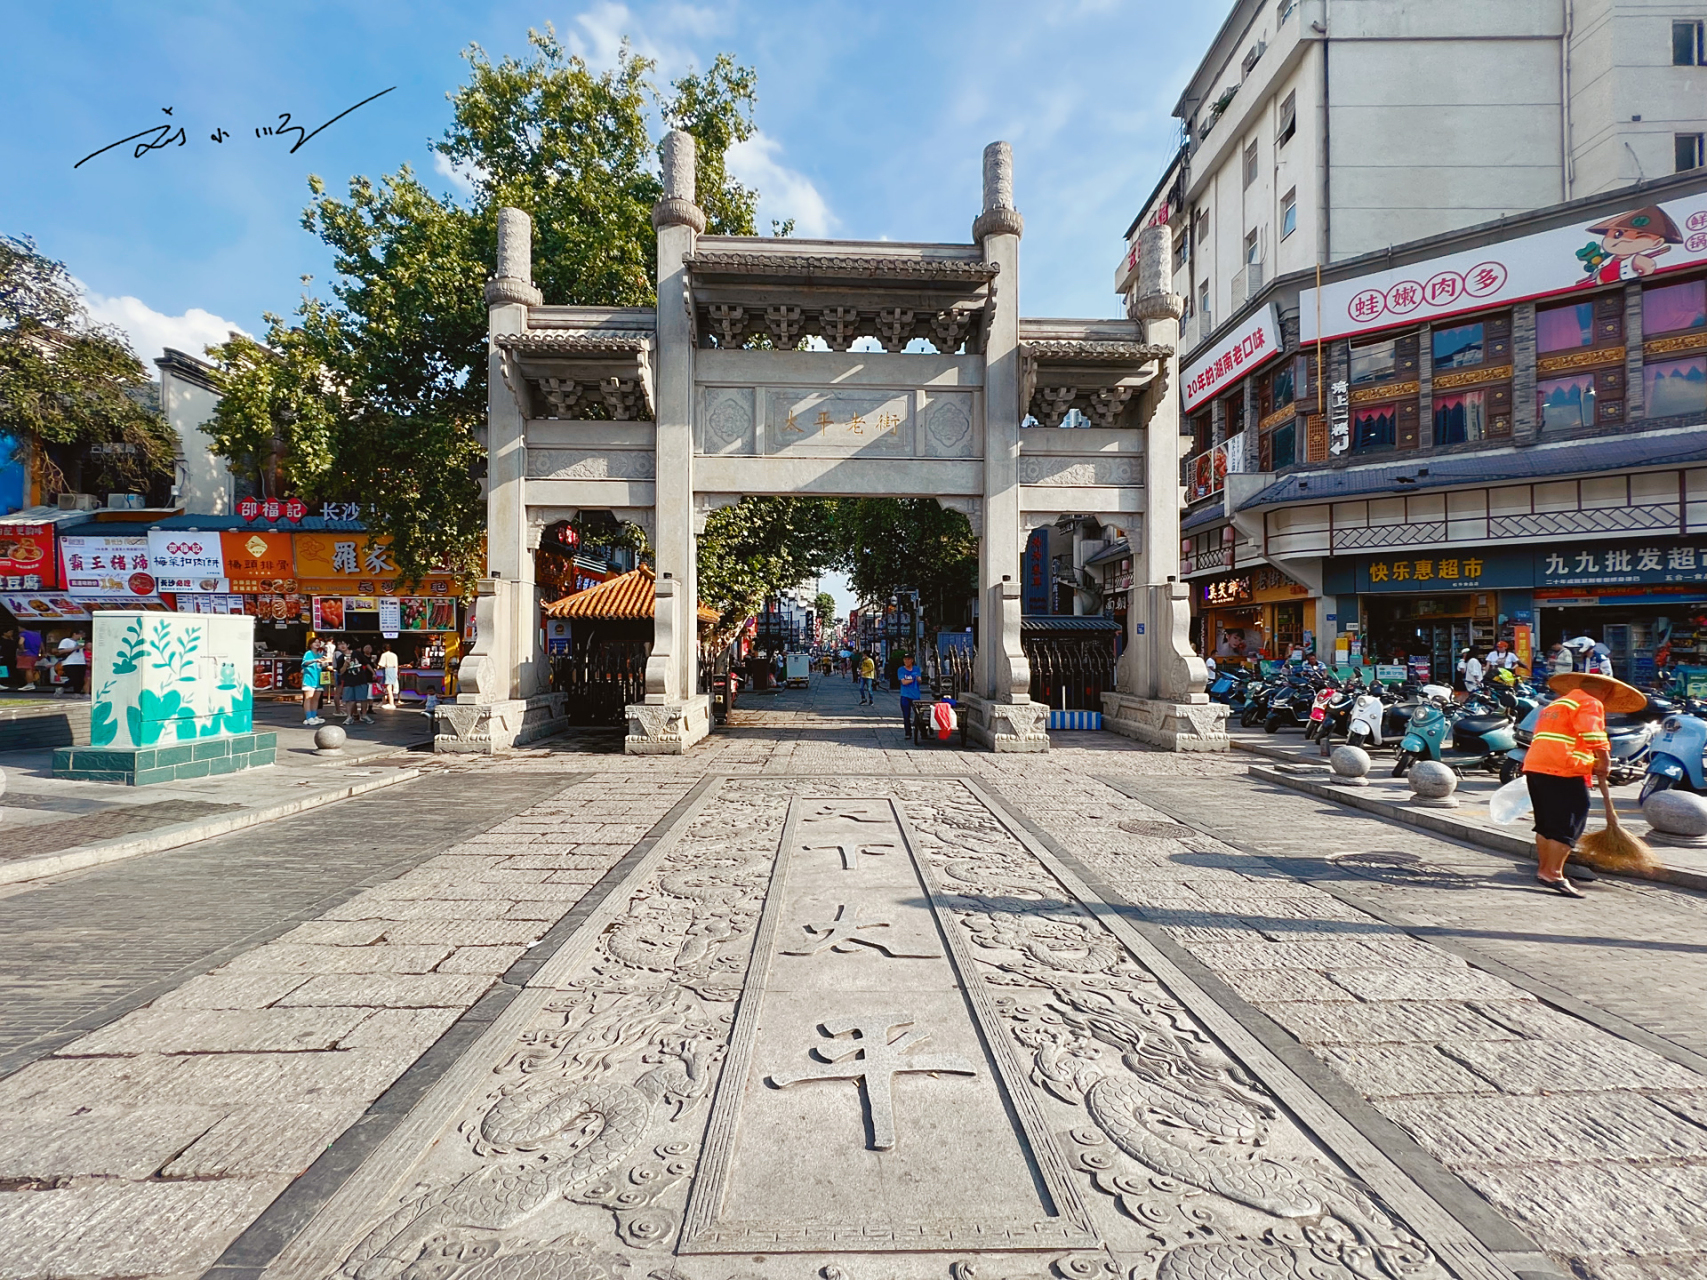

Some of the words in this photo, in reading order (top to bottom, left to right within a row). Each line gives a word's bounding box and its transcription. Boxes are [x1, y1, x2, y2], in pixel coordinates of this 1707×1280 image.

[1355, 268, 1499, 318] 蛙嫩肉多
[1187, 327, 1265, 399] 20年的湖南老口味
[781, 410, 900, 437] 太平老街
[241, 502, 302, 518] 邵福記
[69, 554, 148, 571] 霸王猪蹄
[1369, 557, 1483, 582] 快乐惠超市
